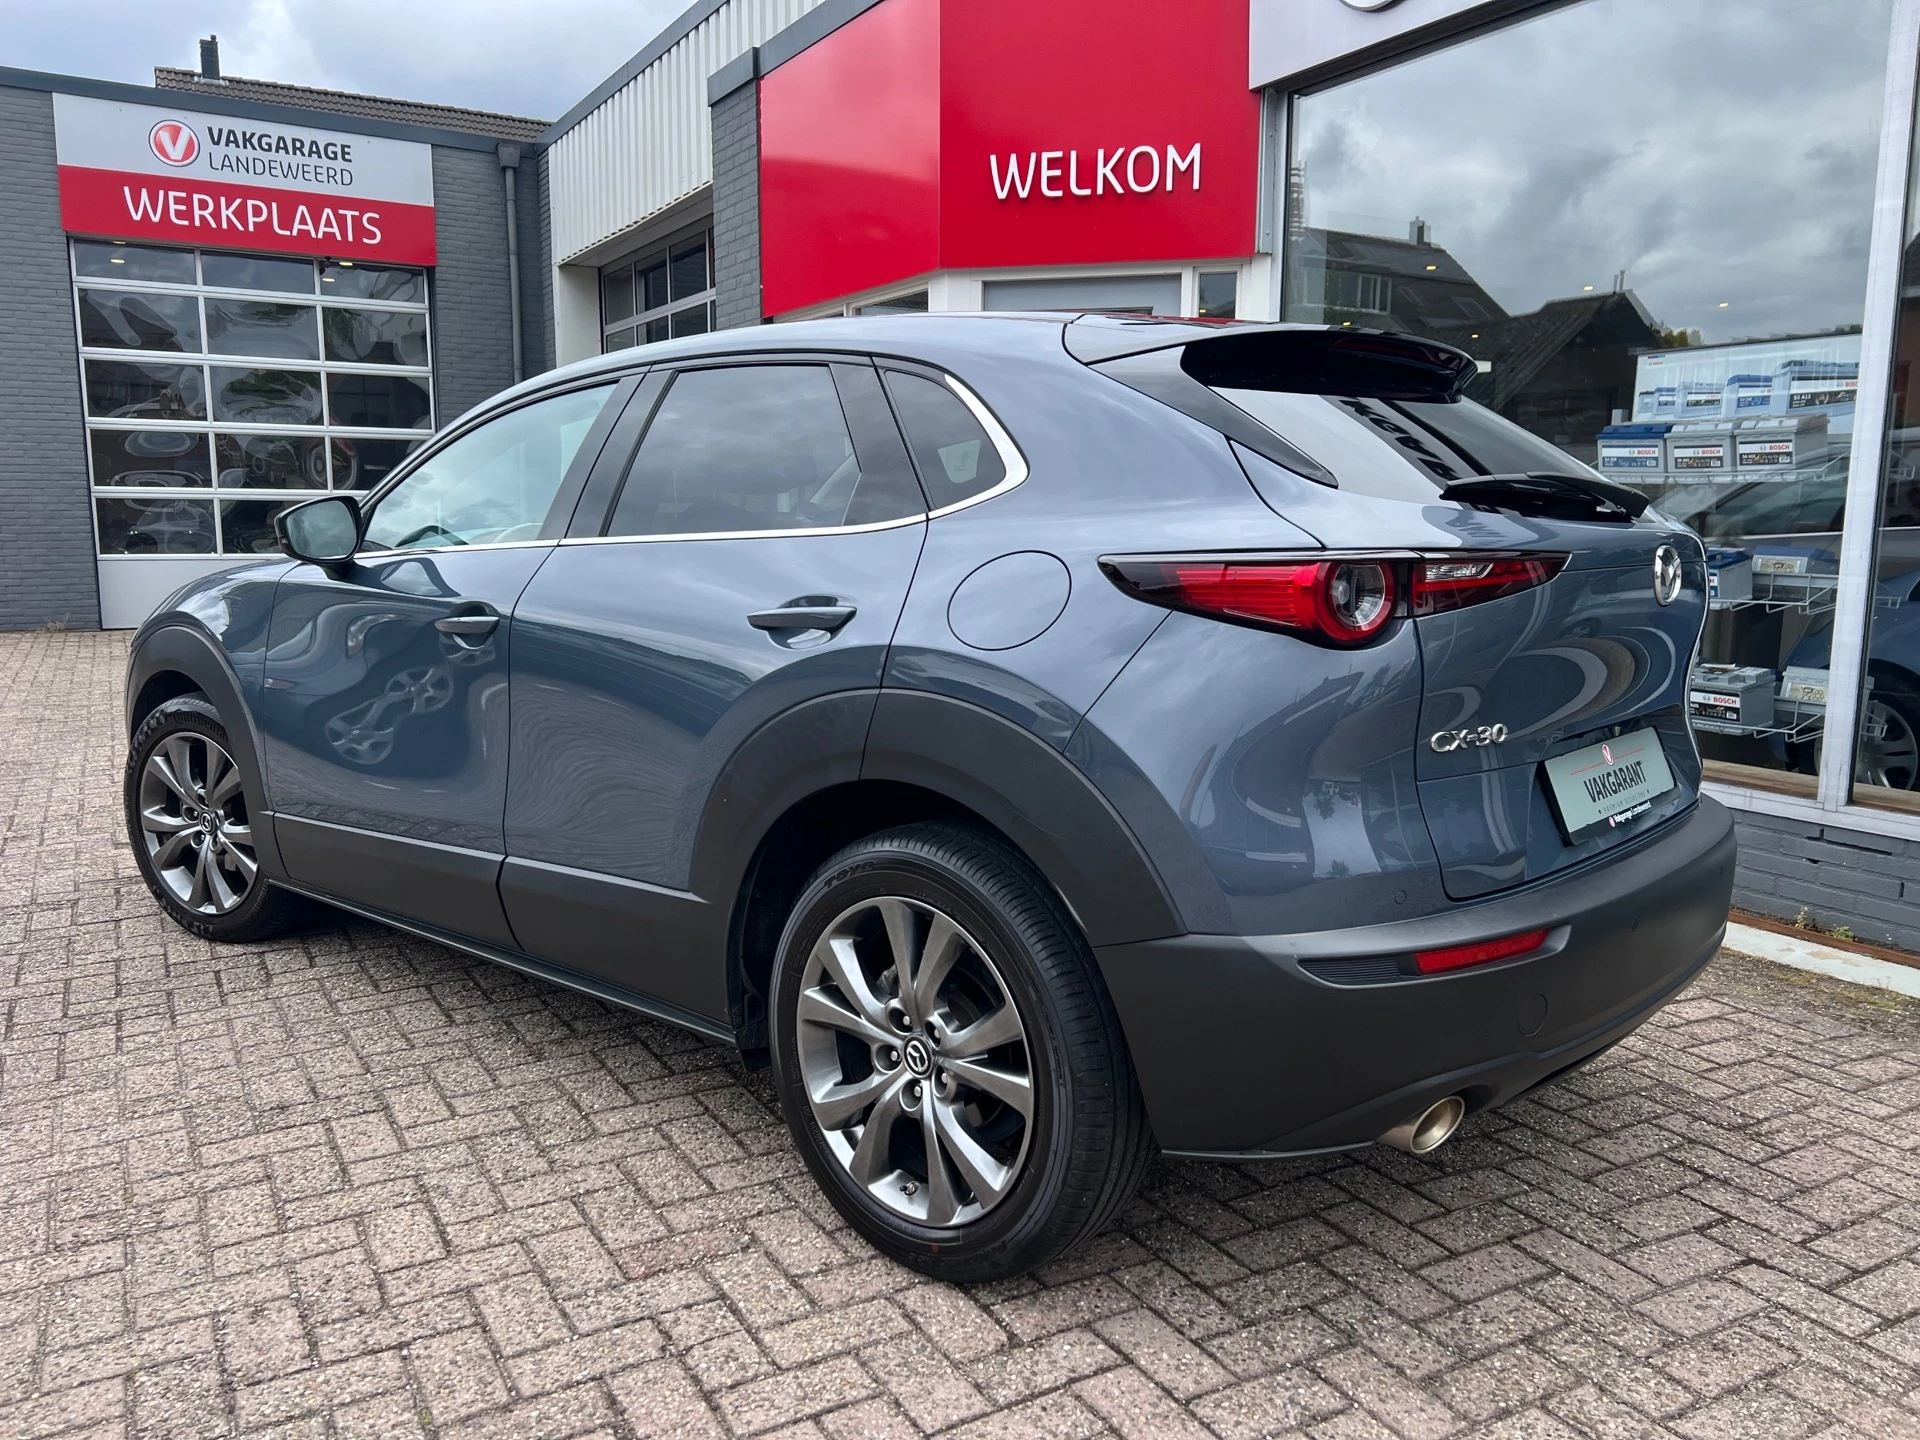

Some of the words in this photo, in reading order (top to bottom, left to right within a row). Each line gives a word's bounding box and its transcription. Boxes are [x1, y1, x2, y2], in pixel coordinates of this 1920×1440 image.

[207, 126, 353, 163] VAKGARAGE
[208, 151, 354, 187] LANDEWEERD
[989, 142, 1201, 200] WELKOM
[122, 185, 382, 245] WERKPLAATS
[1713, 696, 1737, 705] BOSCH
[1430, 723, 1508, 752] CX-30
[1583, 760, 1647, 803] VAKGARANT
[824, 860, 876, 889] TOYO
